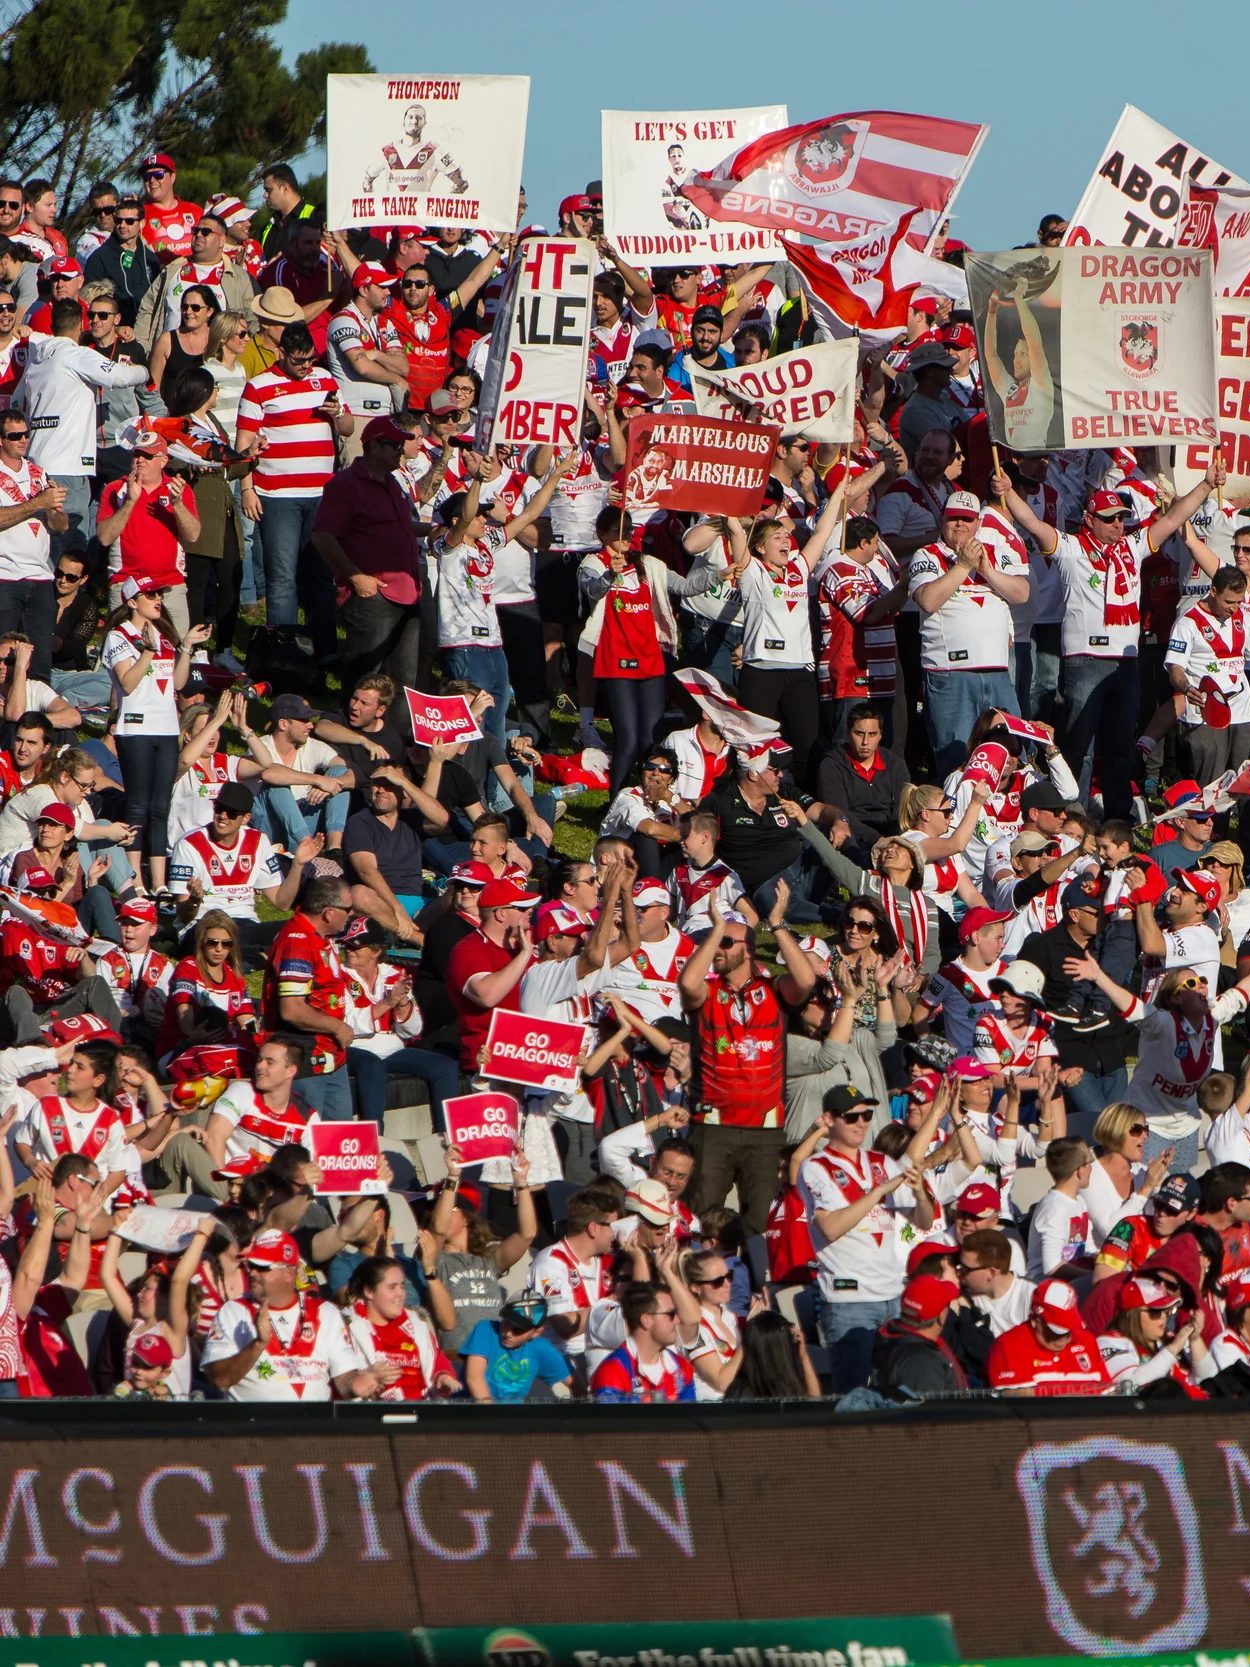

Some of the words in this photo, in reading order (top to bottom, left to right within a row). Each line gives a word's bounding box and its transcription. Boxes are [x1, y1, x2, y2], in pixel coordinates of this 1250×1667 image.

[388, 81, 461, 100] THOMPSON
[694, 120, 736, 141] GET
[353, 198, 377, 216] THE
[382, 197, 418, 216] TANK
[426, 198, 479, 219] ENGINE
[616, 229, 785, 254] WIDDOP-ULOUS
[1080, 255, 1202, 278] DRAGON
[1099, 281, 1183, 305] ARMY
[1105, 390, 1179, 413] TRUE
[1071, 415, 1217, 440] BELIEVERS
[651, 424, 770, 455] MARVELLOUS
[671, 458, 764, 488] MARSHALL
[956, 491, 974, 509] LA
[1190, 513, 1212, 528] Jeep
[415, 715, 470, 732] DRAGONS!
[424, 707, 442, 721] GO
[524, 1031, 548, 1048] GO
[492, 1042, 572, 1069] DRAGONS!
[484, 1107, 507, 1123] GO
[341, 1138, 359, 1154] GO
[318, 1155, 377, 1171] DRAGONS!
[470, 1282, 486, 1294] 52
[454, 1299, 469, 1307] NEW
[487, 1298, 500, 1307] CITY
